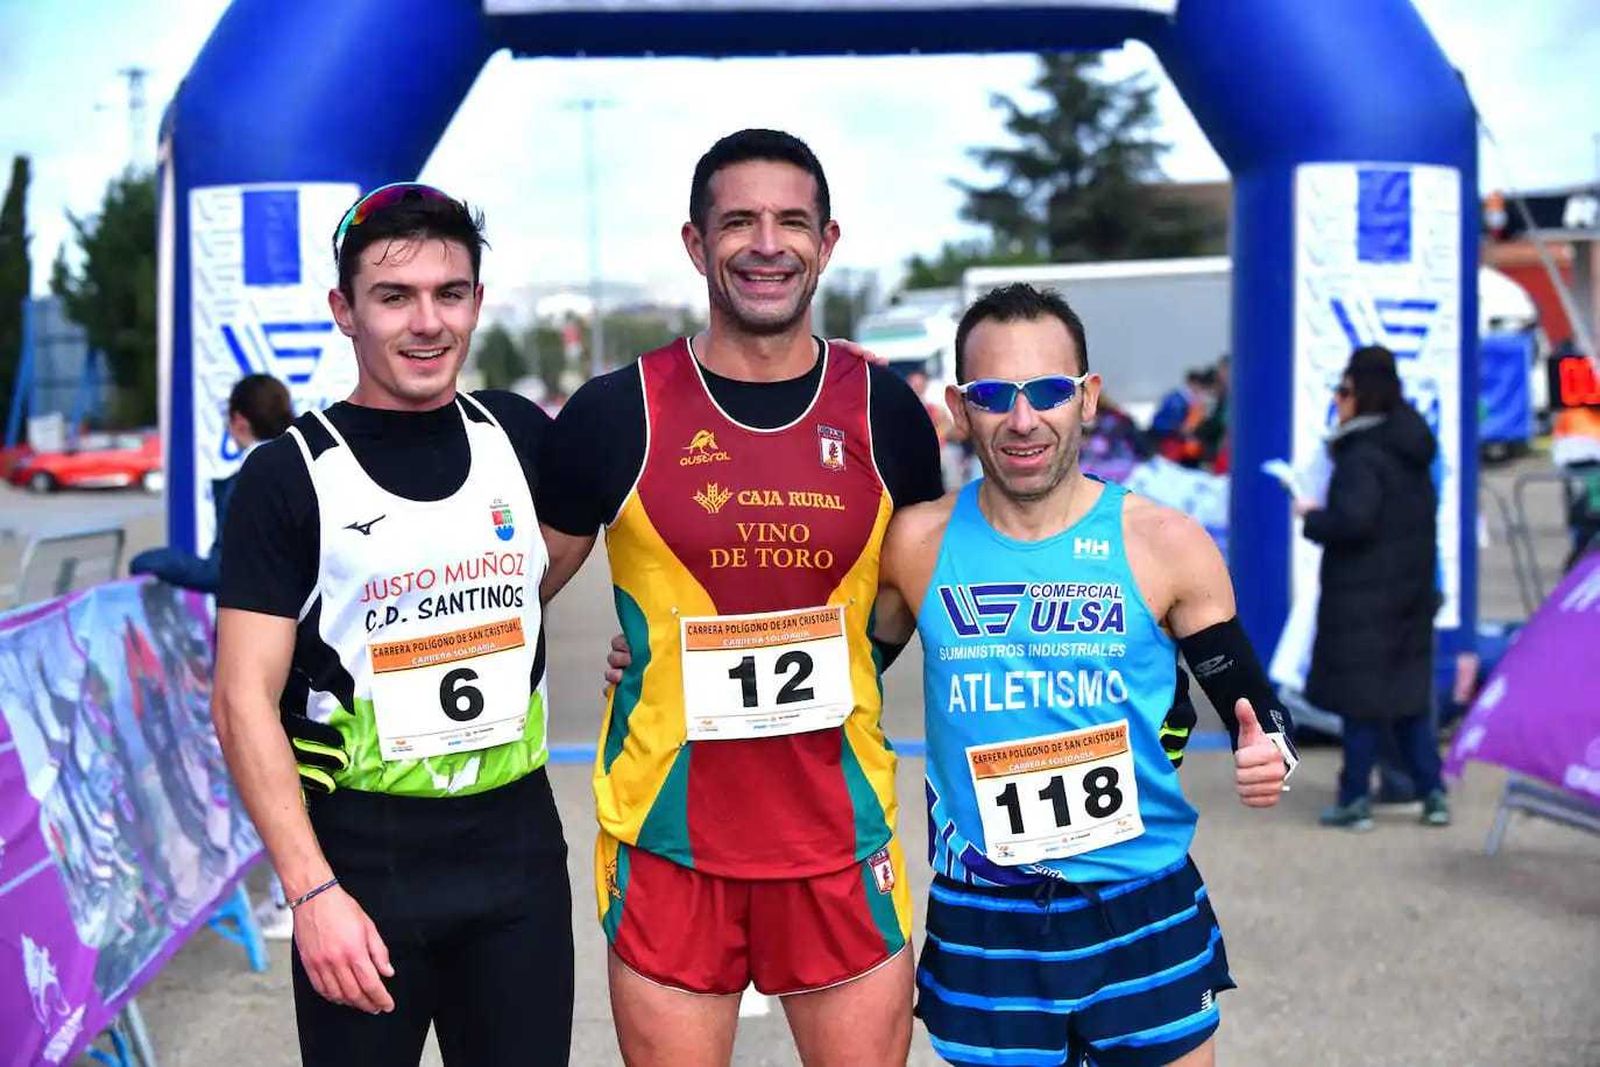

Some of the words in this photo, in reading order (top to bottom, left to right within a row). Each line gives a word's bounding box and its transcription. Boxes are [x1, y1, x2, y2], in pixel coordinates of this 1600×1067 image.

[680, 451, 731, 466] austral
[737, 490, 784, 507] CAJA
[788, 491, 845, 510] RURAL
[736, 522, 810, 543] VINO
[710, 549, 748, 569] DE
[755, 549, 834, 570] TORO
[359, 568, 436, 603] JUSTO
[445, 551, 525, 585] MUÑOZ
[1030, 584, 1123, 599] COMERCIAL
[365, 606, 408, 633] C.D.
[418, 584, 524, 619] SANTINOS
[1030, 601, 1125, 633] ULSA
[687, 625, 723, 635] CARRERA
[770, 620, 781, 630] DE
[782, 617, 797, 629] SAN
[373, 643, 411, 658] CARRERA
[456, 633, 467, 644] DE
[468, 630, 483, 642] SAN
[939, 644, 1025, 661] SUMINISTROS
[1028, 642, 1127, 658] INDUSTRIALES
[728, 650, 815, 708] 12
[948, 669, 1129, 713] ATLETISMO
[440, 667, 485, 722] 6
[973, 751, 1008, 764] CARRERA
[1051, 742, 1062, 752] DE
[1064, 740, 1080, 751] SAN
[995, 766, 1123, 835] 118
